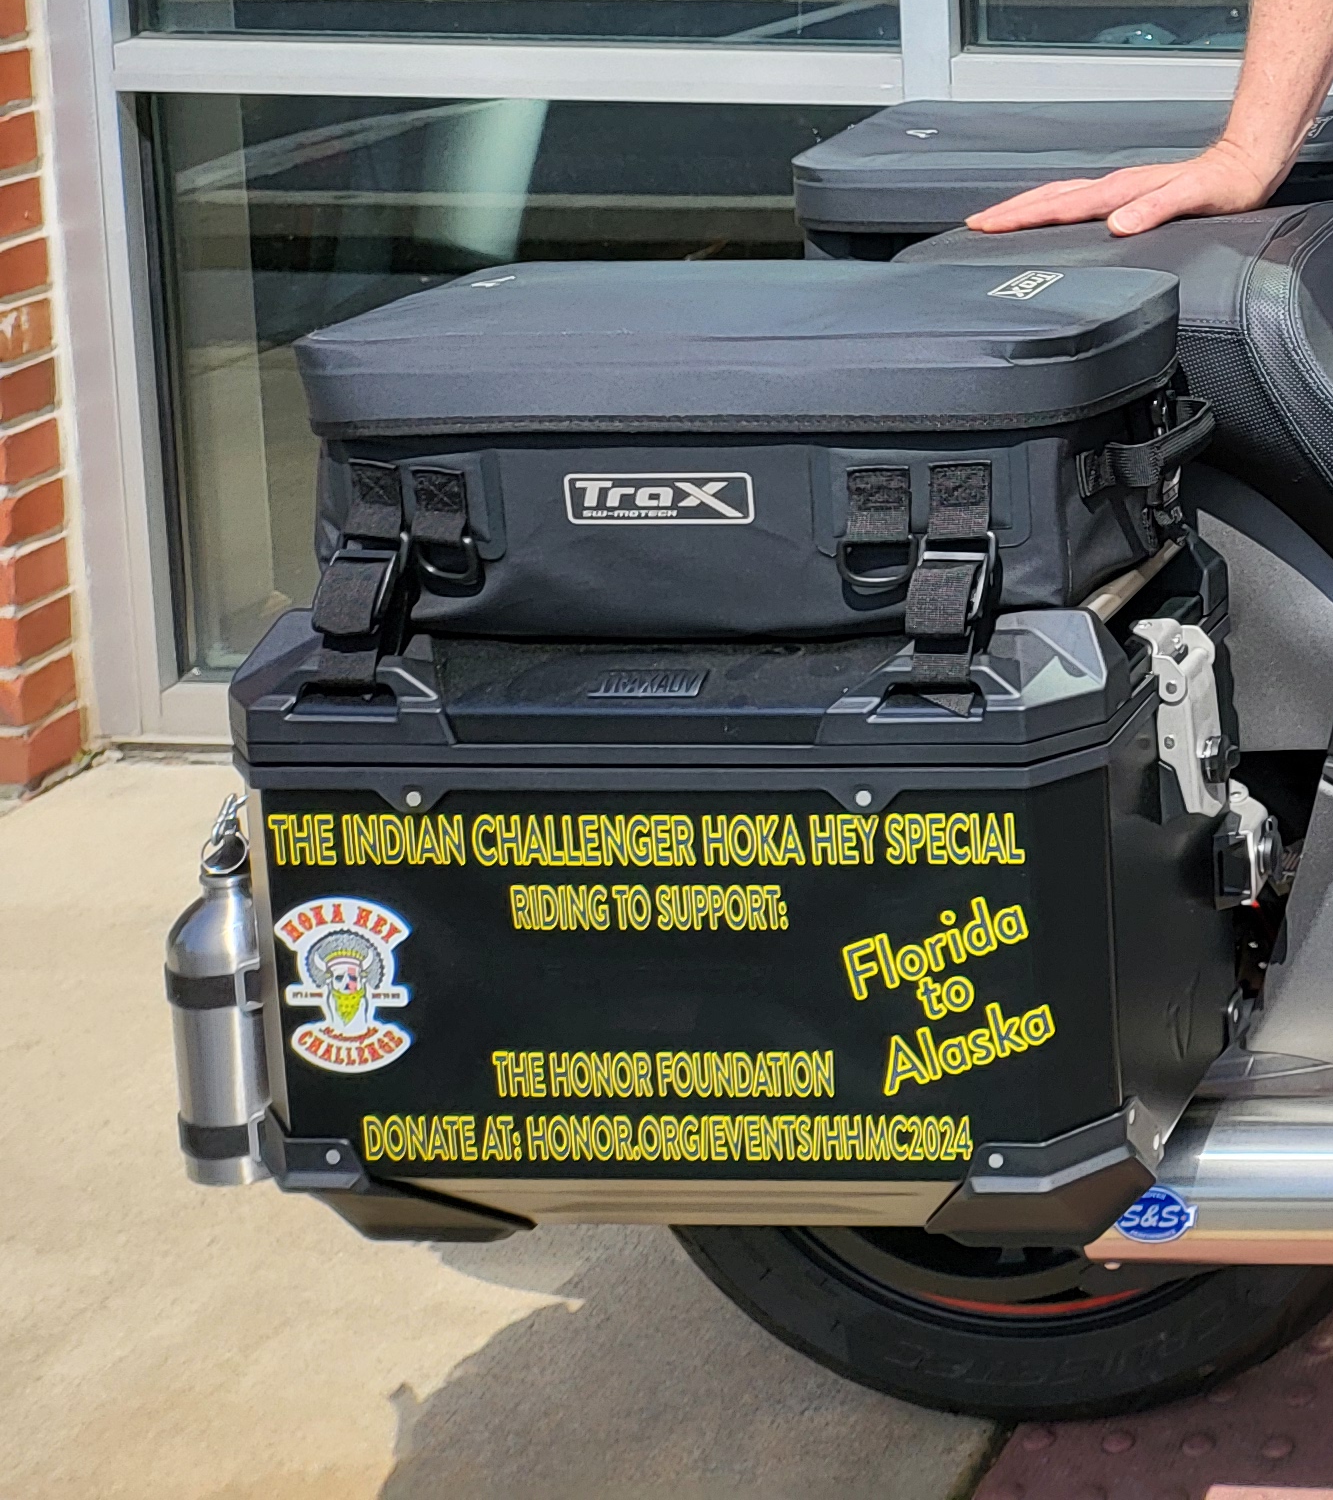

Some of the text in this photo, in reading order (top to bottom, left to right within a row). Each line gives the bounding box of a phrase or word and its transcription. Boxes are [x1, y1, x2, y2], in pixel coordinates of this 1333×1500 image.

[268, 812, 1026, 867] THE INDIAN CHALLENGER HOKA HEY SPECIAL
[281, 903, 402, 944] HOKA HEY
[510, 884, 789, 932] RIDING TO SUPPORT:
[842, 896, 1029, 1000] Florida
[916, 975, 975, 1020] to
[883, 1002, 1056, 1096] Alaska
[492, 1049, 835, 1098] THE HONOR FOUNDATION
[363, 1114, 974, 1162] DONATE AT: HONOR.ORG/EVENTS/HHMC2024
[1120, 1203, 1182, 1228] S&S
